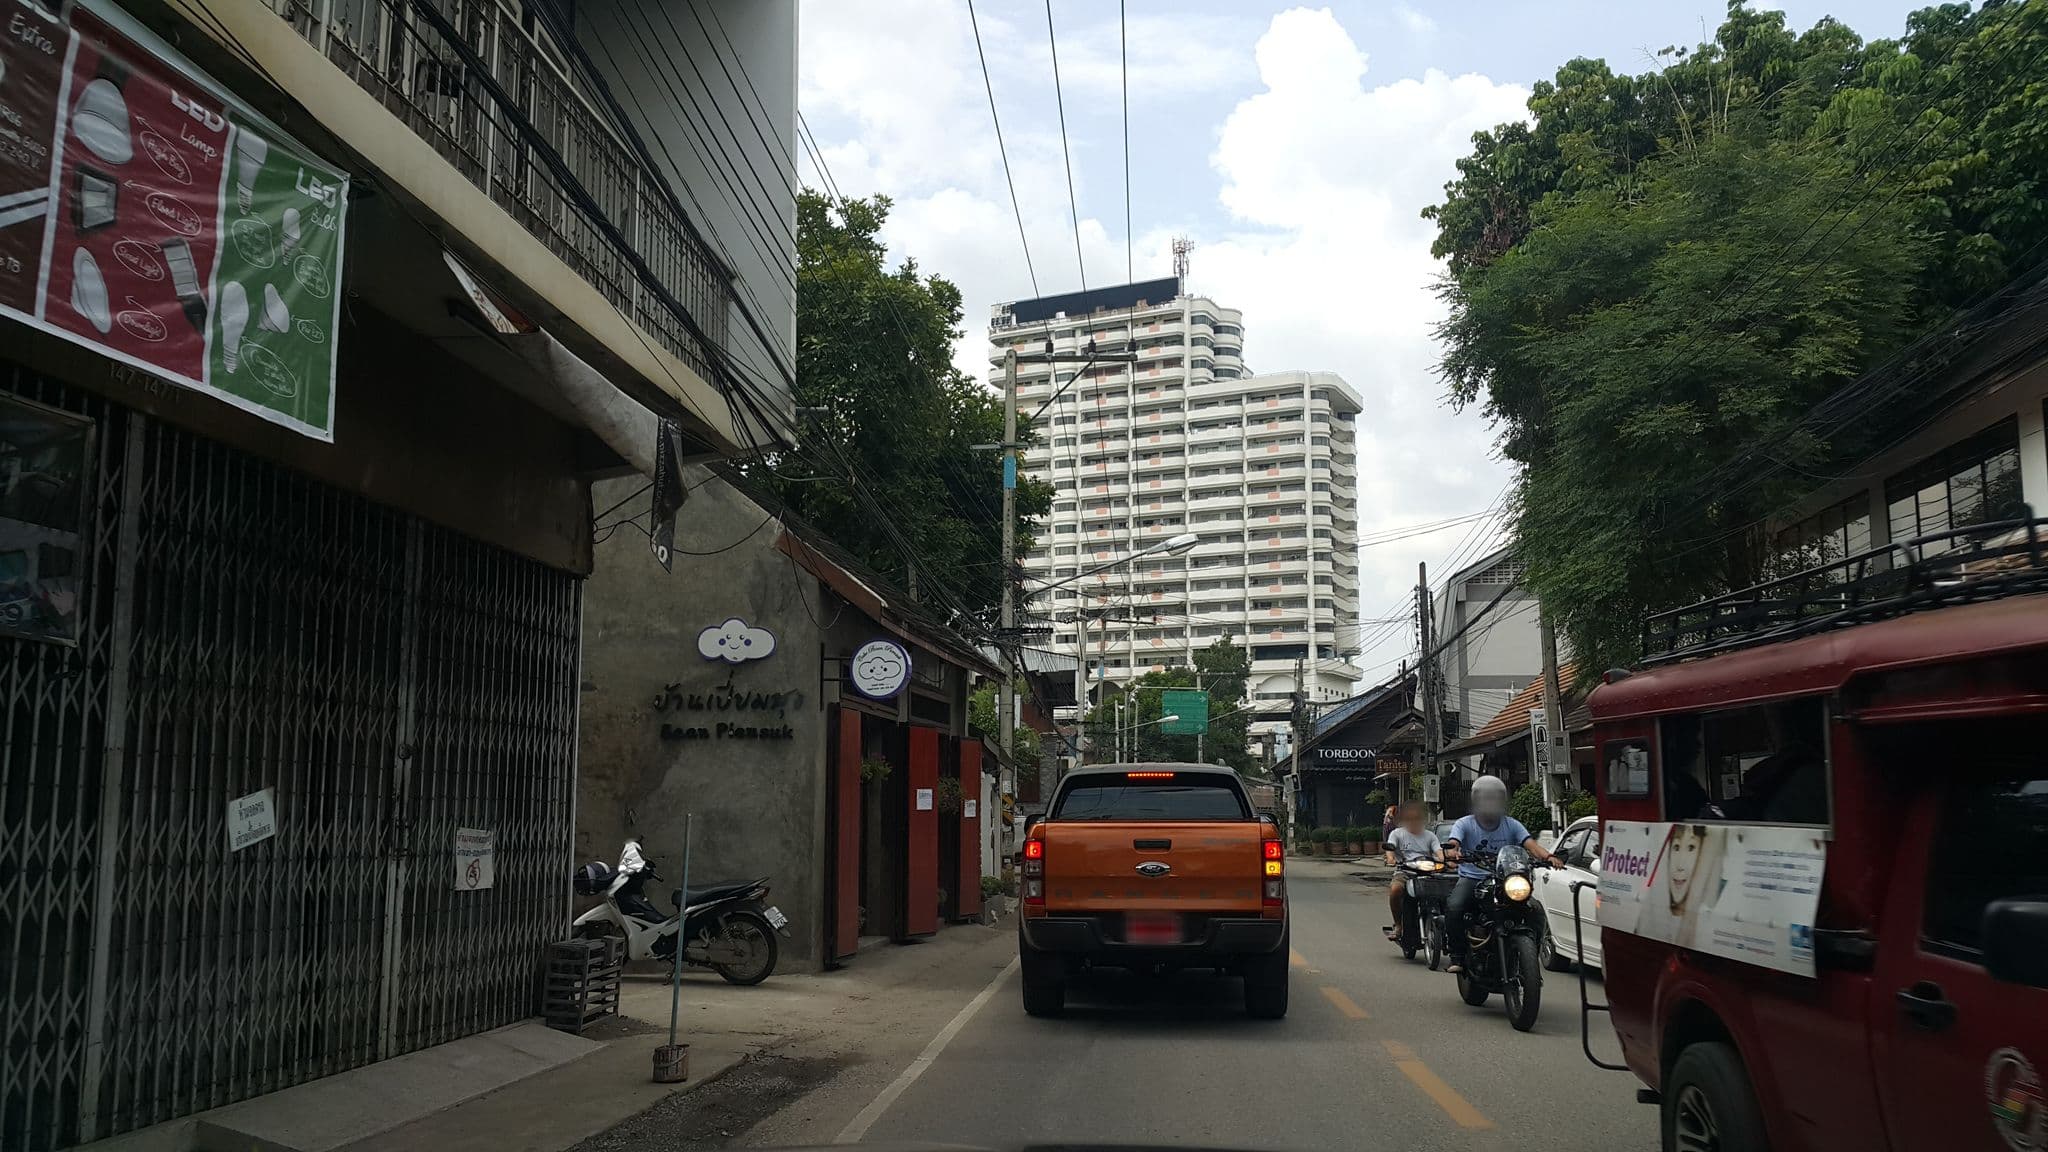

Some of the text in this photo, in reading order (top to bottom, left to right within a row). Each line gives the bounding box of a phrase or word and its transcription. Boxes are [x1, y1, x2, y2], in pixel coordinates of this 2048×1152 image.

[171, 88, 225, 133] LED
[181, 122, 218, 163] Lamp
[295, 166, 337, 209] LED
[660, 722, 794, 740] Baan Piemsuk
[1318, 748, 1376, 759] TORBOON
[1377, 758, 1408, 770] Tanita
[1603, 846, 1650, 877] iProtect
